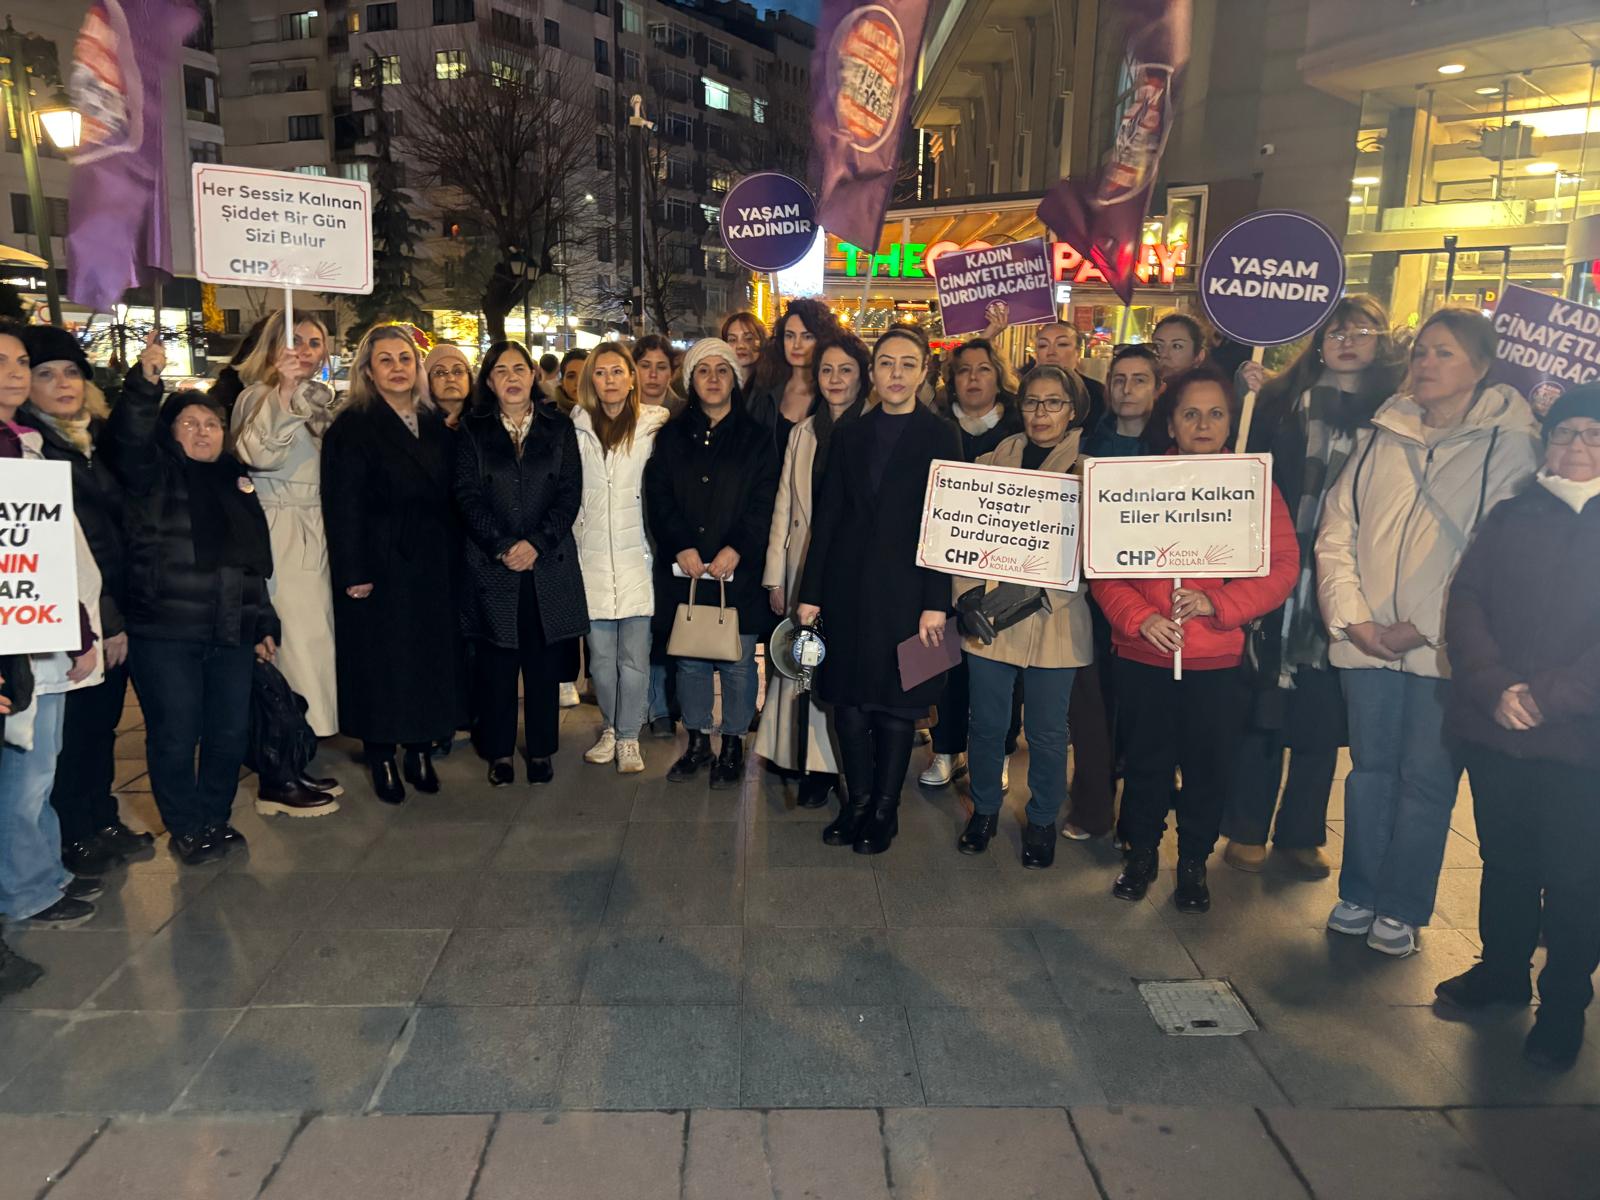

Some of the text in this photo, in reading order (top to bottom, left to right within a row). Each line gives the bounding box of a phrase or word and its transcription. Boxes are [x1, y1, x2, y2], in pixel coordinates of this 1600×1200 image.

[203, 181, 362, 211] Her Sessiz Kalınan
[221, 204, 346, 229] Şiddet Bir Gün
[738, 203, 800, 222] YAŞAM
[246, 228, 326, 248] Sizi Bulur
[728, 219, 811, 239] KADINDIR
[230, 258, 269, 275] CHP
[837, 242, 927, 278] THE
[966, 247, 1012, 269] KADIN
[1230, 256, 1319, 279] YAŞAM
[940, 255, 1044, 291] CİNAYETLERİNİ
[941, 273, 1048, 307] DURDURACAĞIZ
[1209, 277, 1330, 303] KADINDIR
[936, 471, 1081, 503] İstanbul Sözleşmesi
[1098, 486, 1255, 503] Kadınlara Kalkan
[978, 497, 1031, 514] Yaşatır
[1120, 508, 1232, 524] Eller Kırılsın!
[932, 508, 1075, 537] Kadın Cinayetlerini
[950, 526, 1050, 551] Durduracağız
[945, 549, 979, 565] CHP
[1116, 550, 1157, 566] CHP
[0, 604, 63, 625] YOK.
